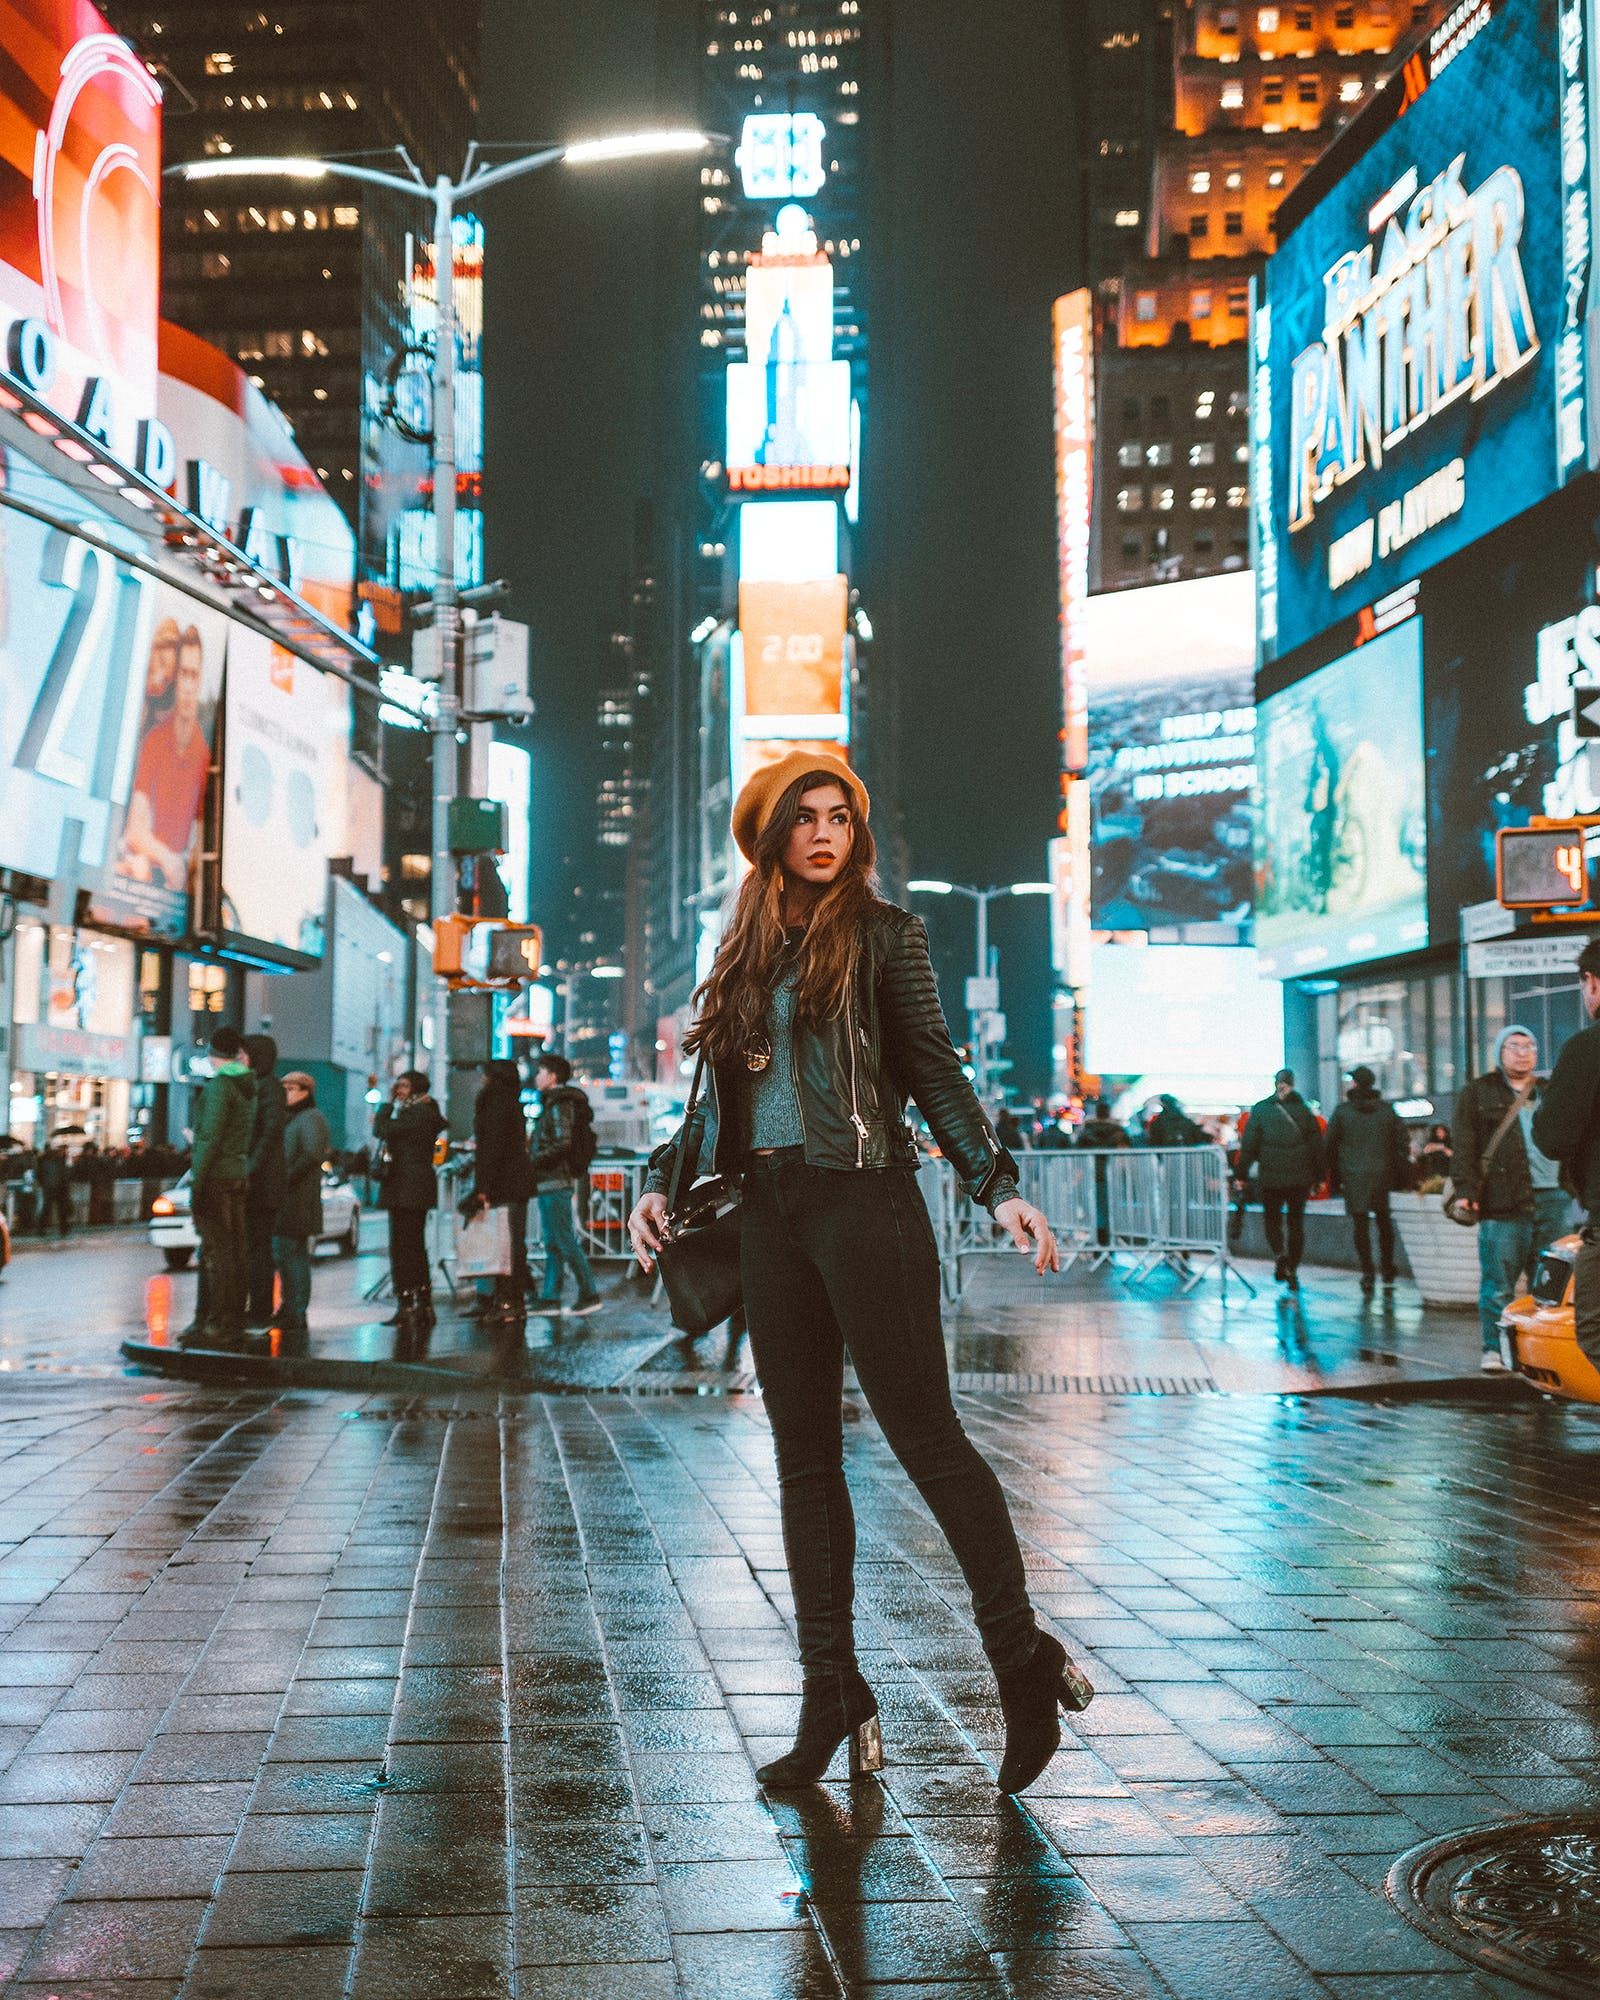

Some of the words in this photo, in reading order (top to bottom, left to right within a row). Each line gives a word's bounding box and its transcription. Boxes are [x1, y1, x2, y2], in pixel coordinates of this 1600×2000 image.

[1323, 152, 1471, 340] BLACK
[1287, 165, 1542, 534] PANTHER
[727, 463, 850, 490] TOSHIBA
[1378, 457, 1465, 560] PLAYING
[1160, 716, 1222, 741] HELP
[1222, 706, 1258, 735] US
[1132, 774, 1164, 801] IN
[1555, 845, 1583, 893] 4
